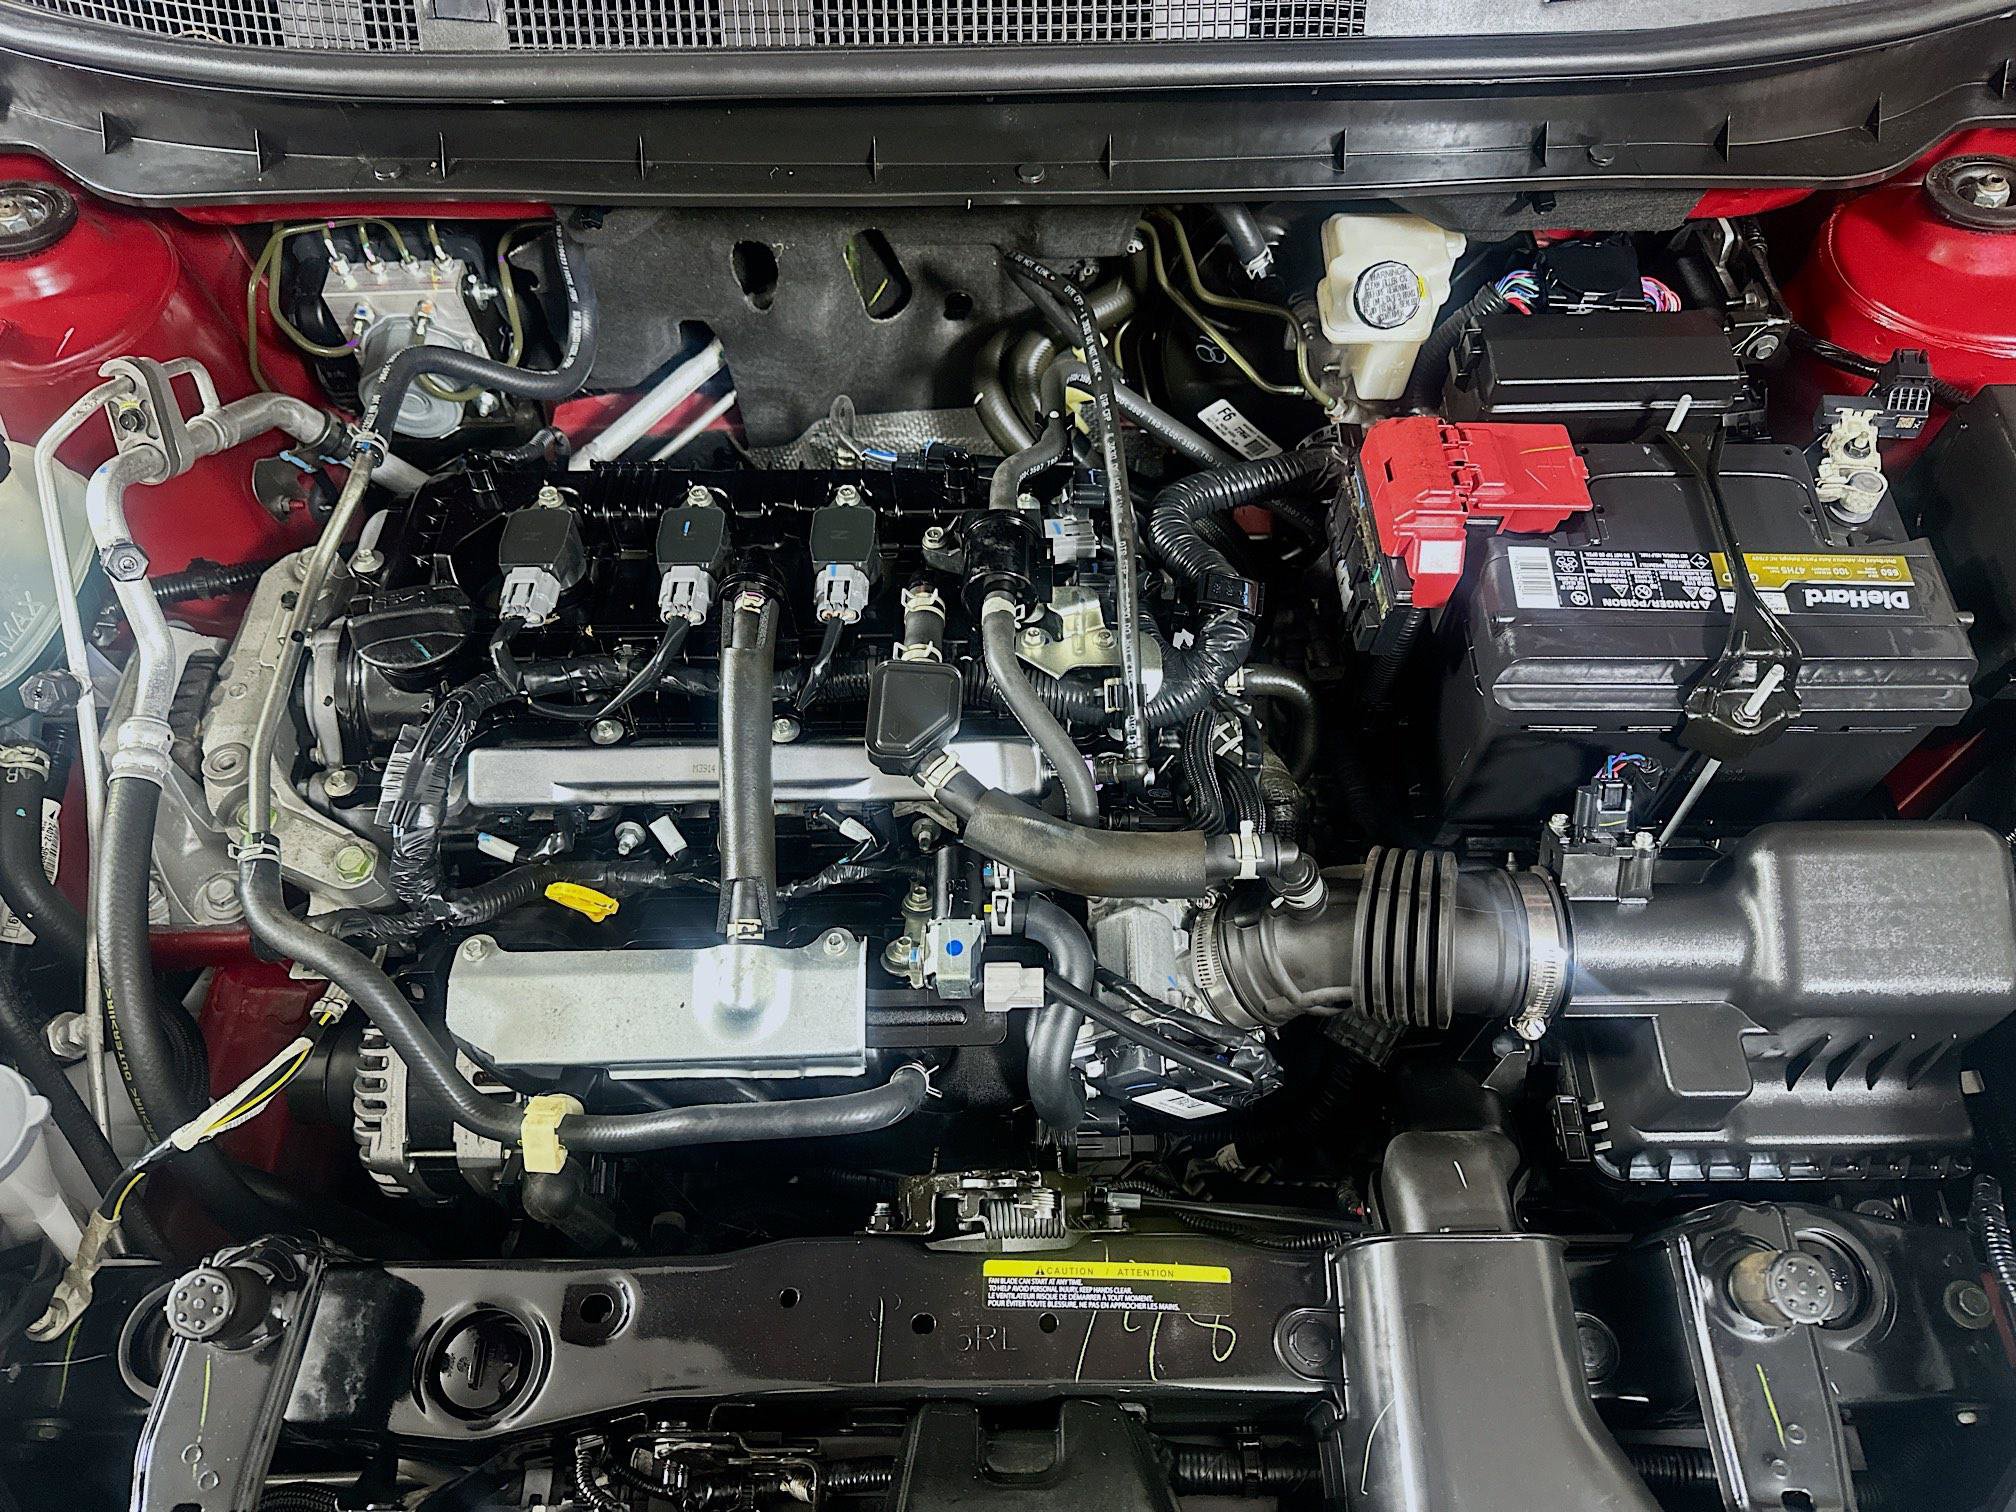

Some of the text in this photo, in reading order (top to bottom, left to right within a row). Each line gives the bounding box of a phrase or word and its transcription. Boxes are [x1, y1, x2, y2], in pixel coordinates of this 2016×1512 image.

[1217, 407, 1236, 422] F6
[1722, 572, 1760, 583] GD
[1602, 598, 1700, 609] DANGER/POISON
[1046, 1267, 1094, 1275] CAUTION
[1117, 1268, 1174, 1278] ATTENTION
[1093, 1286, 1114, 1294] HANDS
[996, 1292, 1036, 1300] VENTILATEUR
[1036, 1293, 1058, 1301] RISQUE
[1068, 1292, 1101, 1301] DÉMARRER
[1107, 1294, 1125, 1302] TOUT
[1124, 1294, 1154, 1303] MOMENT.
[1006, 1299, 1027, 1307] ÉVITER
[1046, 1301, 1079, 1309] BLESSURE,
[1088, 1301, 1100, 1309] PAS
[1109, 1302, 1147, 1310] APPROCHER
[1158, 1303, 1181, 1311] MAINS.
